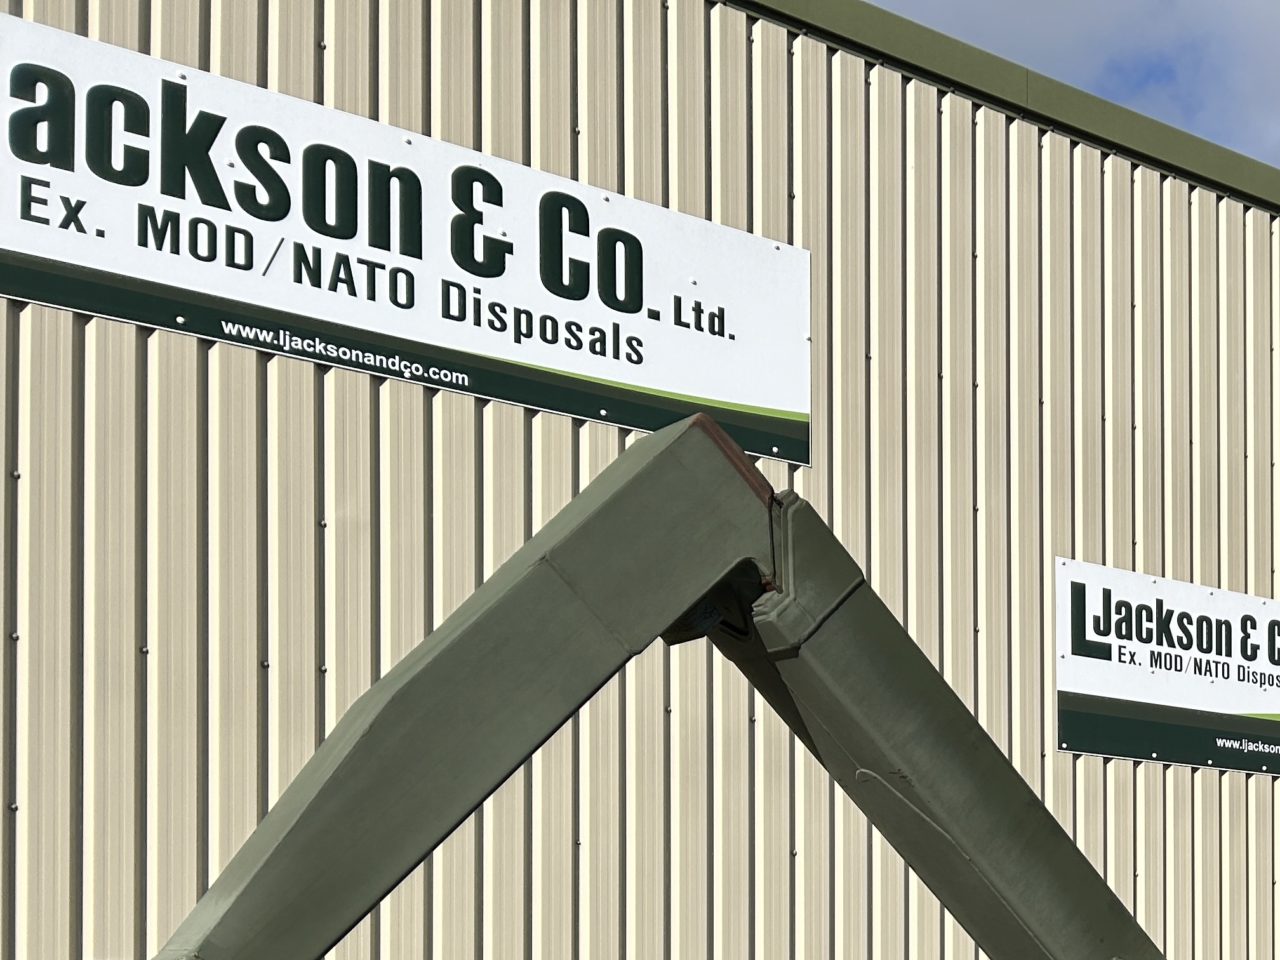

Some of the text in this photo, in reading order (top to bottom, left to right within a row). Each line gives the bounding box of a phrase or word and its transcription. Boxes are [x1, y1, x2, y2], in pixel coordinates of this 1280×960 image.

[20, 175, 644, 365] Ex. MOD/NATO Disposals
[451, 166, 513, 279] &
[539, 192, 661, 322] Co.
[673, 295, 736, 341] Ltd.
[221, 320, 469, 386] www.ljacksonandco.com
[1118, 644, 1142, 667] Ex.
[1149, 650, 1230, 680] MOD/NATO
[1240, 614, 1260, 662] &
